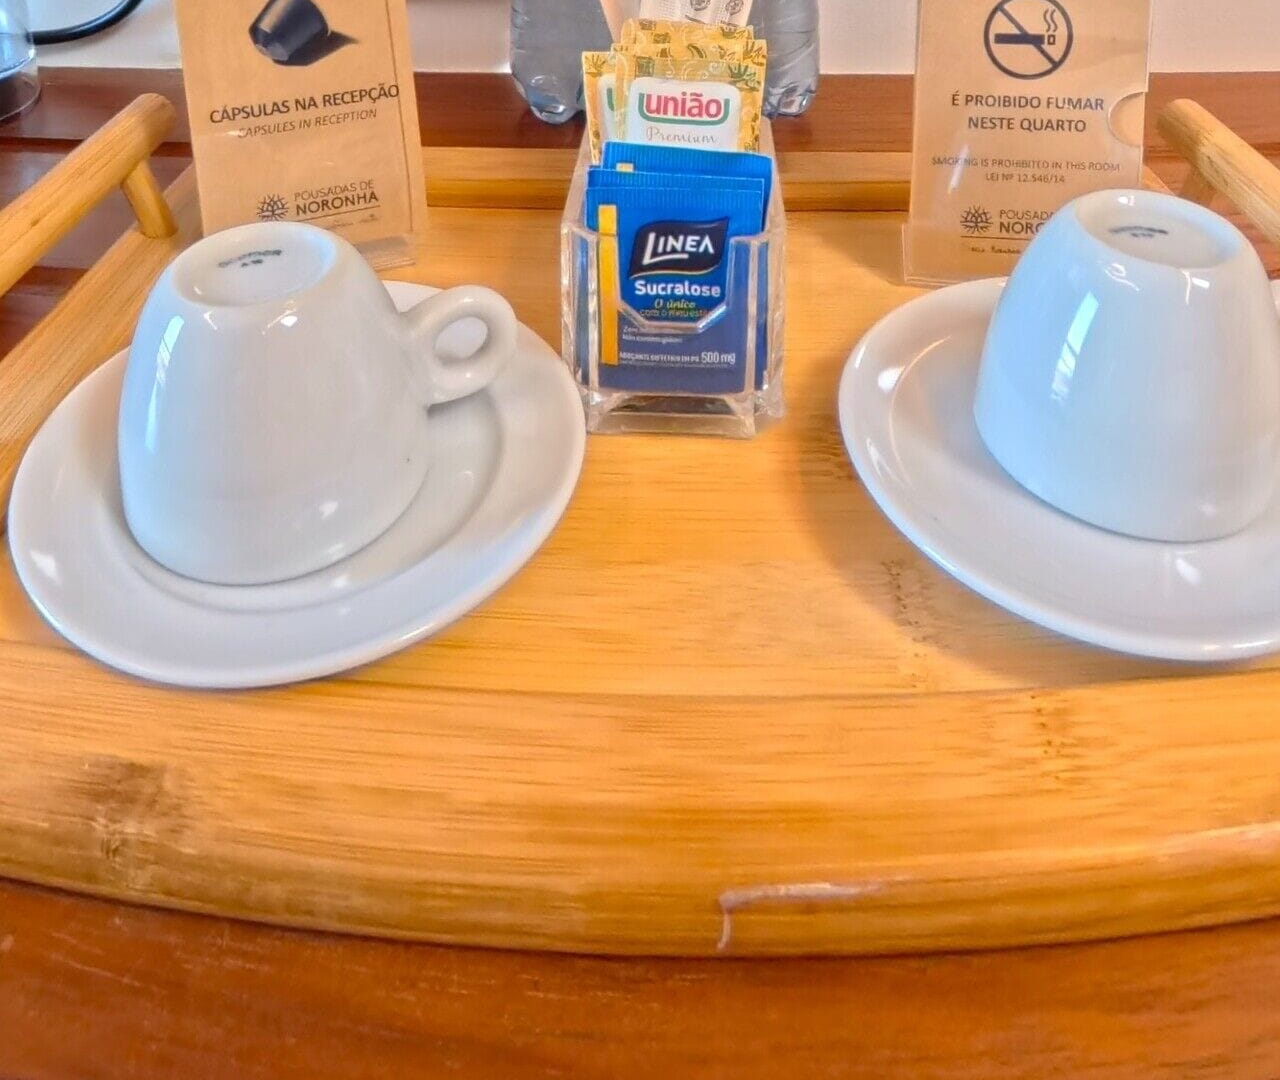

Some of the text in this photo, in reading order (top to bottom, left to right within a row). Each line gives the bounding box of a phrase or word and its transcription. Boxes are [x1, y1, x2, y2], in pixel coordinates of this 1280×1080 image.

[210, 83, 400, 124] CÁPSULAS NA RECEPÇÃO
[646, 91, 722, 118] união
[952, 90, 1104, 111] É PROIBIDO FUMAR
[298, 116, 313, 130] IN
[314, 108, 378, 127] RECEPTION
[968, 116, 1087, 133] NESTE QUARTO
[646, 126, 717, 144] Premium
[980, 158, 989, 168] IS
[992, 158, 1049, 170] PROHIBITED
[1052, 160, 1062, 170] IN
[986, 172, 998, 182] LEI
[294, 178, 375, 202] POUSADAS DE
[295, 190, 379, 216] NORONHA
[642, 232, 715, 266] LINEA
[634, 280, 721, 298] Sucralose
[701, 351, 720, 363] 500
[721, 353, 736, 365] mg
